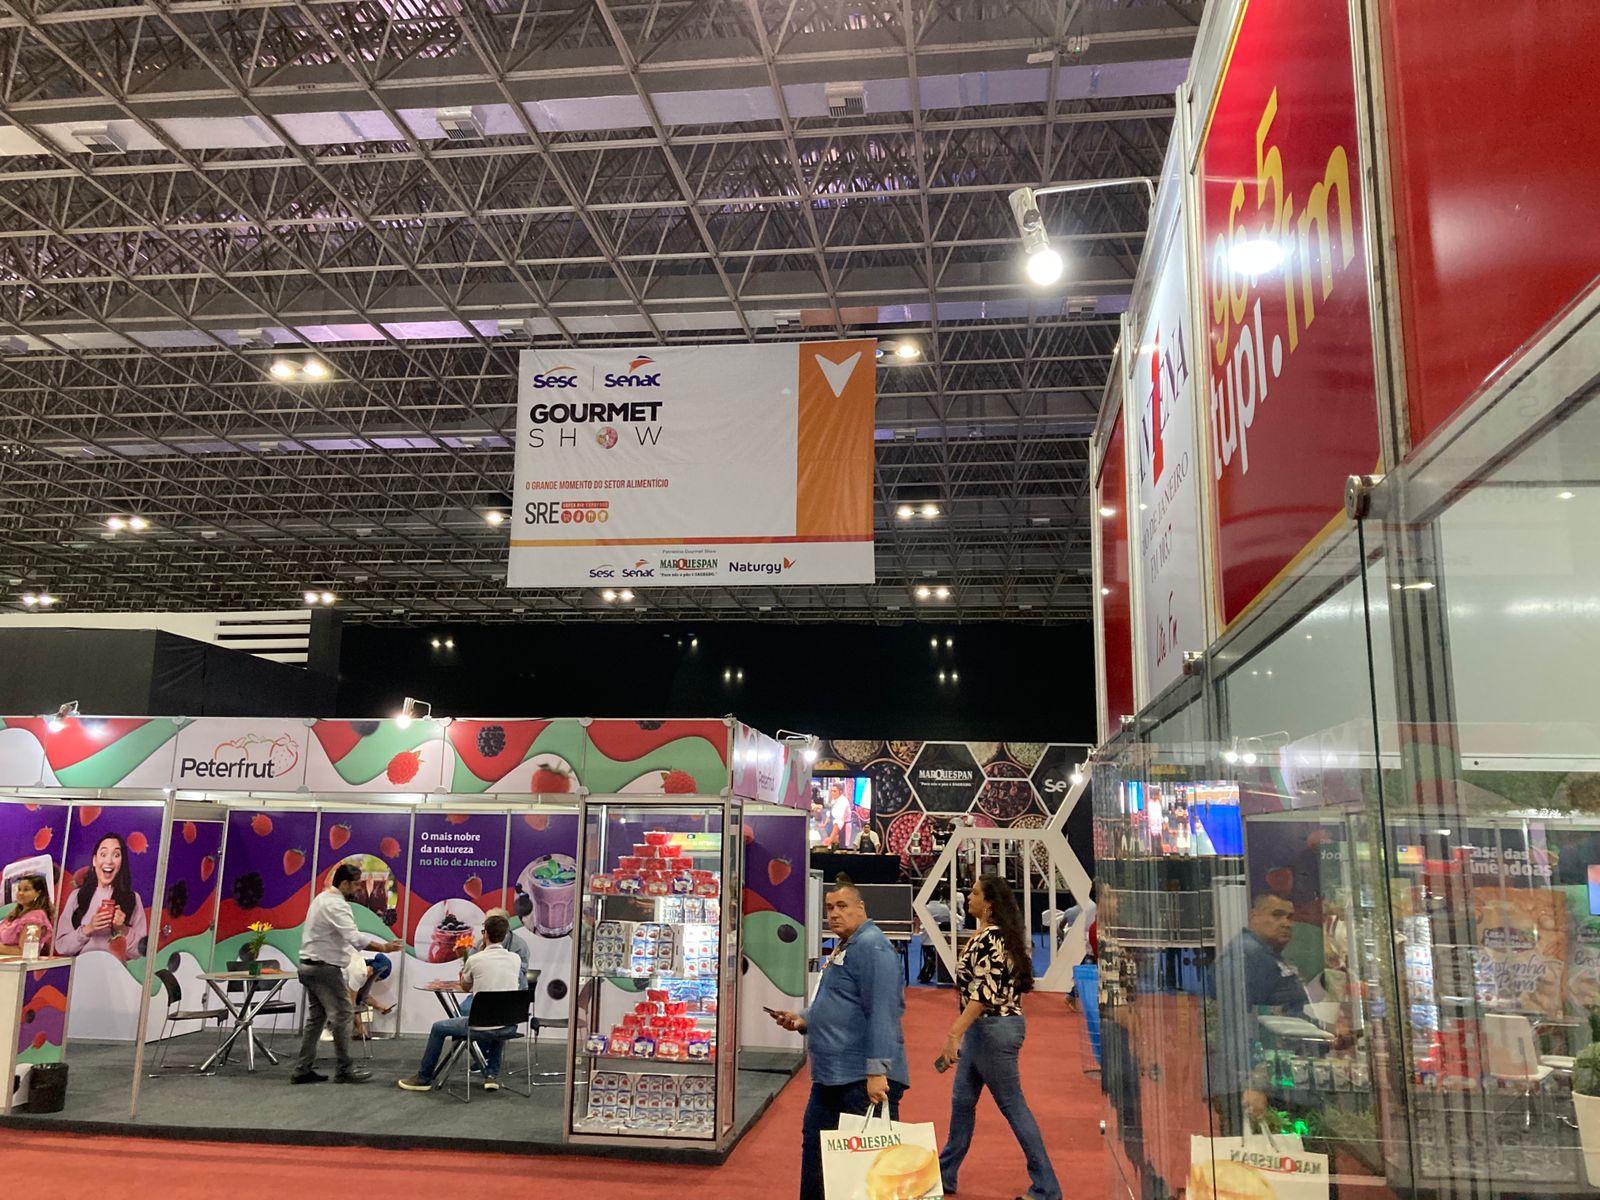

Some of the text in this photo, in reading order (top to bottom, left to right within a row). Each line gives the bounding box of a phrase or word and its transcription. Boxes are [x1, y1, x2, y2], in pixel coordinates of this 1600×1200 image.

[533, 374, 578, 388] Sesc
[604, 373, 661, 388] Senac
[529, 401, 663, 424] GOURMET
[525, 477, 669, 490] O GRANDE MOMENTO DO SETOR ALIMENTÍCIO
[524, 501, 560, 525] SRE
[659, 558, 719, 571] MARQUESPAN
[729, 561, 782, 574] Naturgy
[589, 568, 654, 578] Sesc Senac
[180, 757, 275, 779] Peterfrut
[918, 769, 974, 781] MARQUESPAN
[421, 831, 481, 842] O mais nobre
[420, 844, 474, 854] da natureza
[419, 857, 498, 867] no Rio de Janeiro
[827, 1133, 902, 1152] MARQUESPAN
